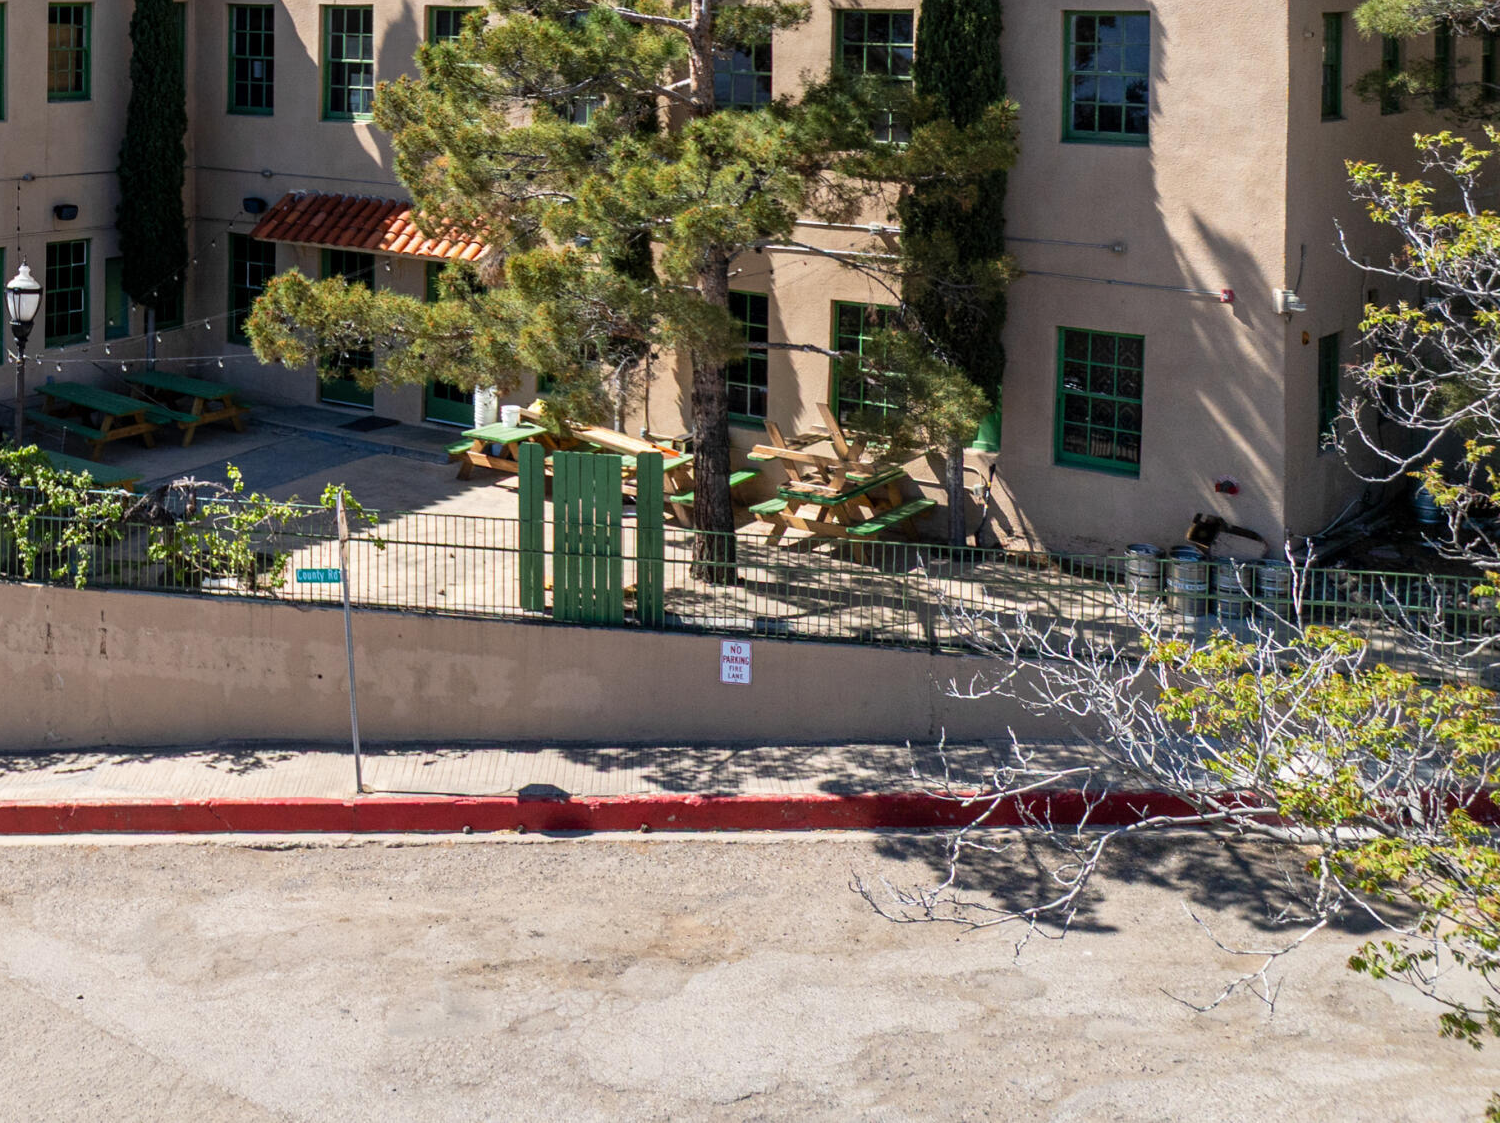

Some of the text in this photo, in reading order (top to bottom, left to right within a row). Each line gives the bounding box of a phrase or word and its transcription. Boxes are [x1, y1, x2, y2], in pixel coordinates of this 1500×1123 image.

[297, 569, 338, 582] County Rd
[730, 645, 742, 654] NO
[723, 655, 749, 665] PARKING
[728, 672, 744, 680] LANE
